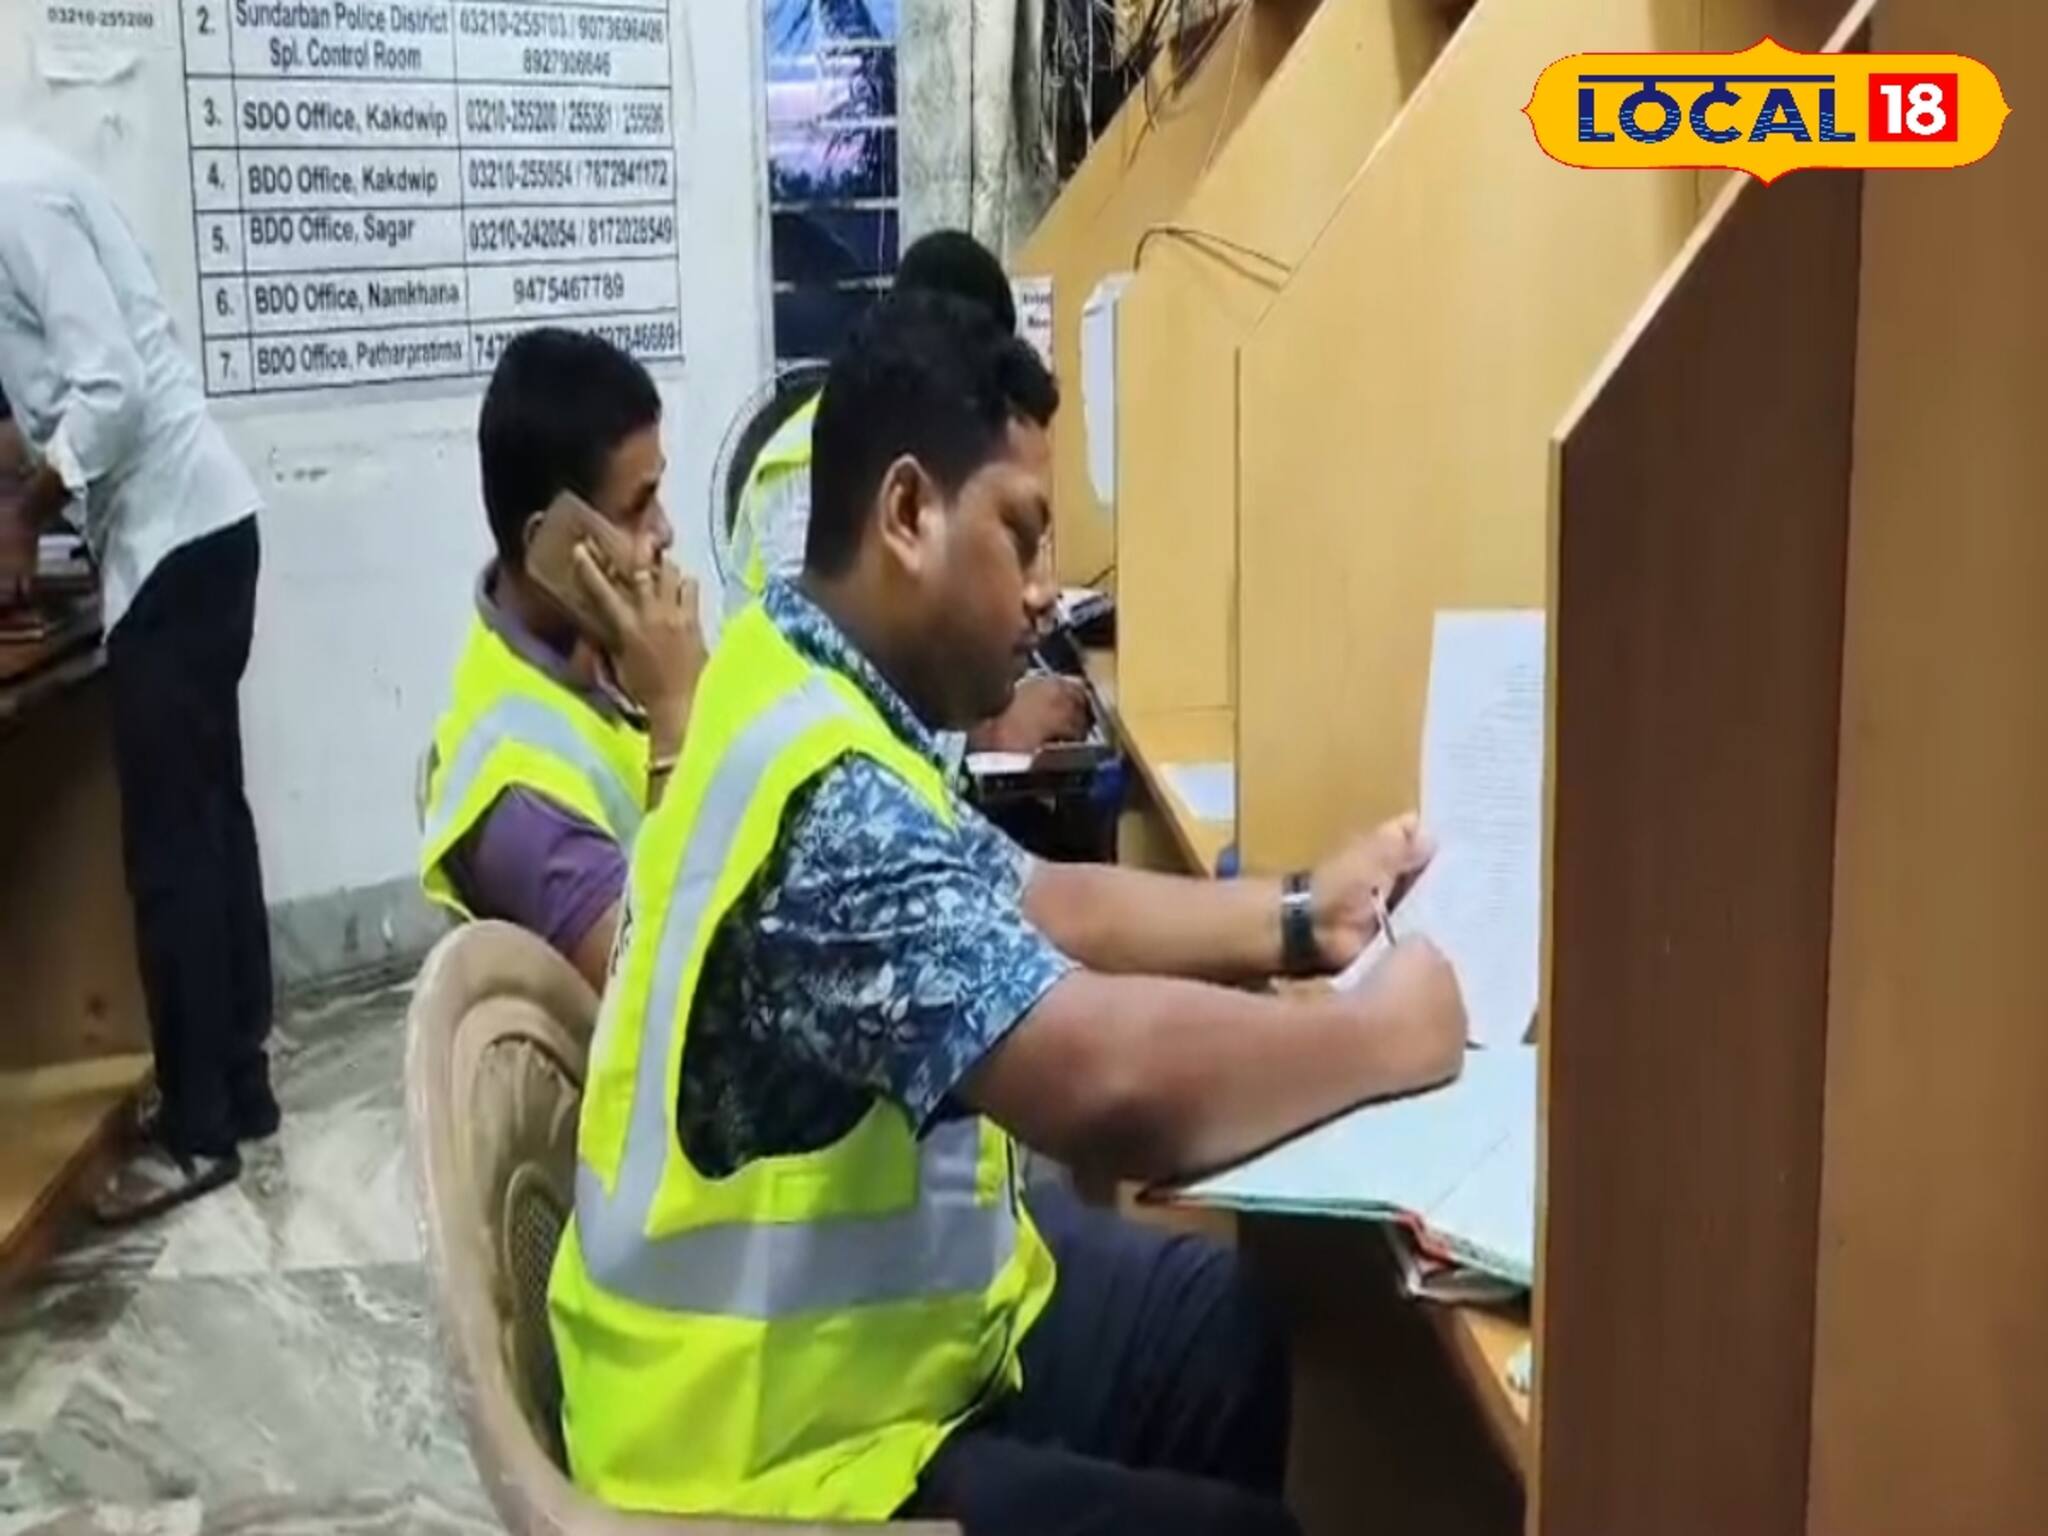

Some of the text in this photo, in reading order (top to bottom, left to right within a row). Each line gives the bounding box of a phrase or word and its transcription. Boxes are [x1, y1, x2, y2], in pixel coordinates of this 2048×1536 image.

[197, 6, 215, 35] 2.
[236, 0, 448, 34] Sundarban Police District
[269, 37, 422, 71] Spl. Control Room
[203, 97, 221, 127] 3.
[243, 101, 448, 136] SDO Office, Kakdwip
[207, 161, 225, 190] 4.
[248, 165, 438, 196] BDO Office, Kakdwip
[211, 225, 229, 254] 5.
[250, 214, 415, 248] BDO Office, Sagar
[215, 288, 234, 316] 6.
[255, 282, 460, 314] BDO Office, Namkhana
[513, 272, 625, 304] 9475467789
[219, 351, 238, 378] 7.
[256, 346, 296, 375] BDO
